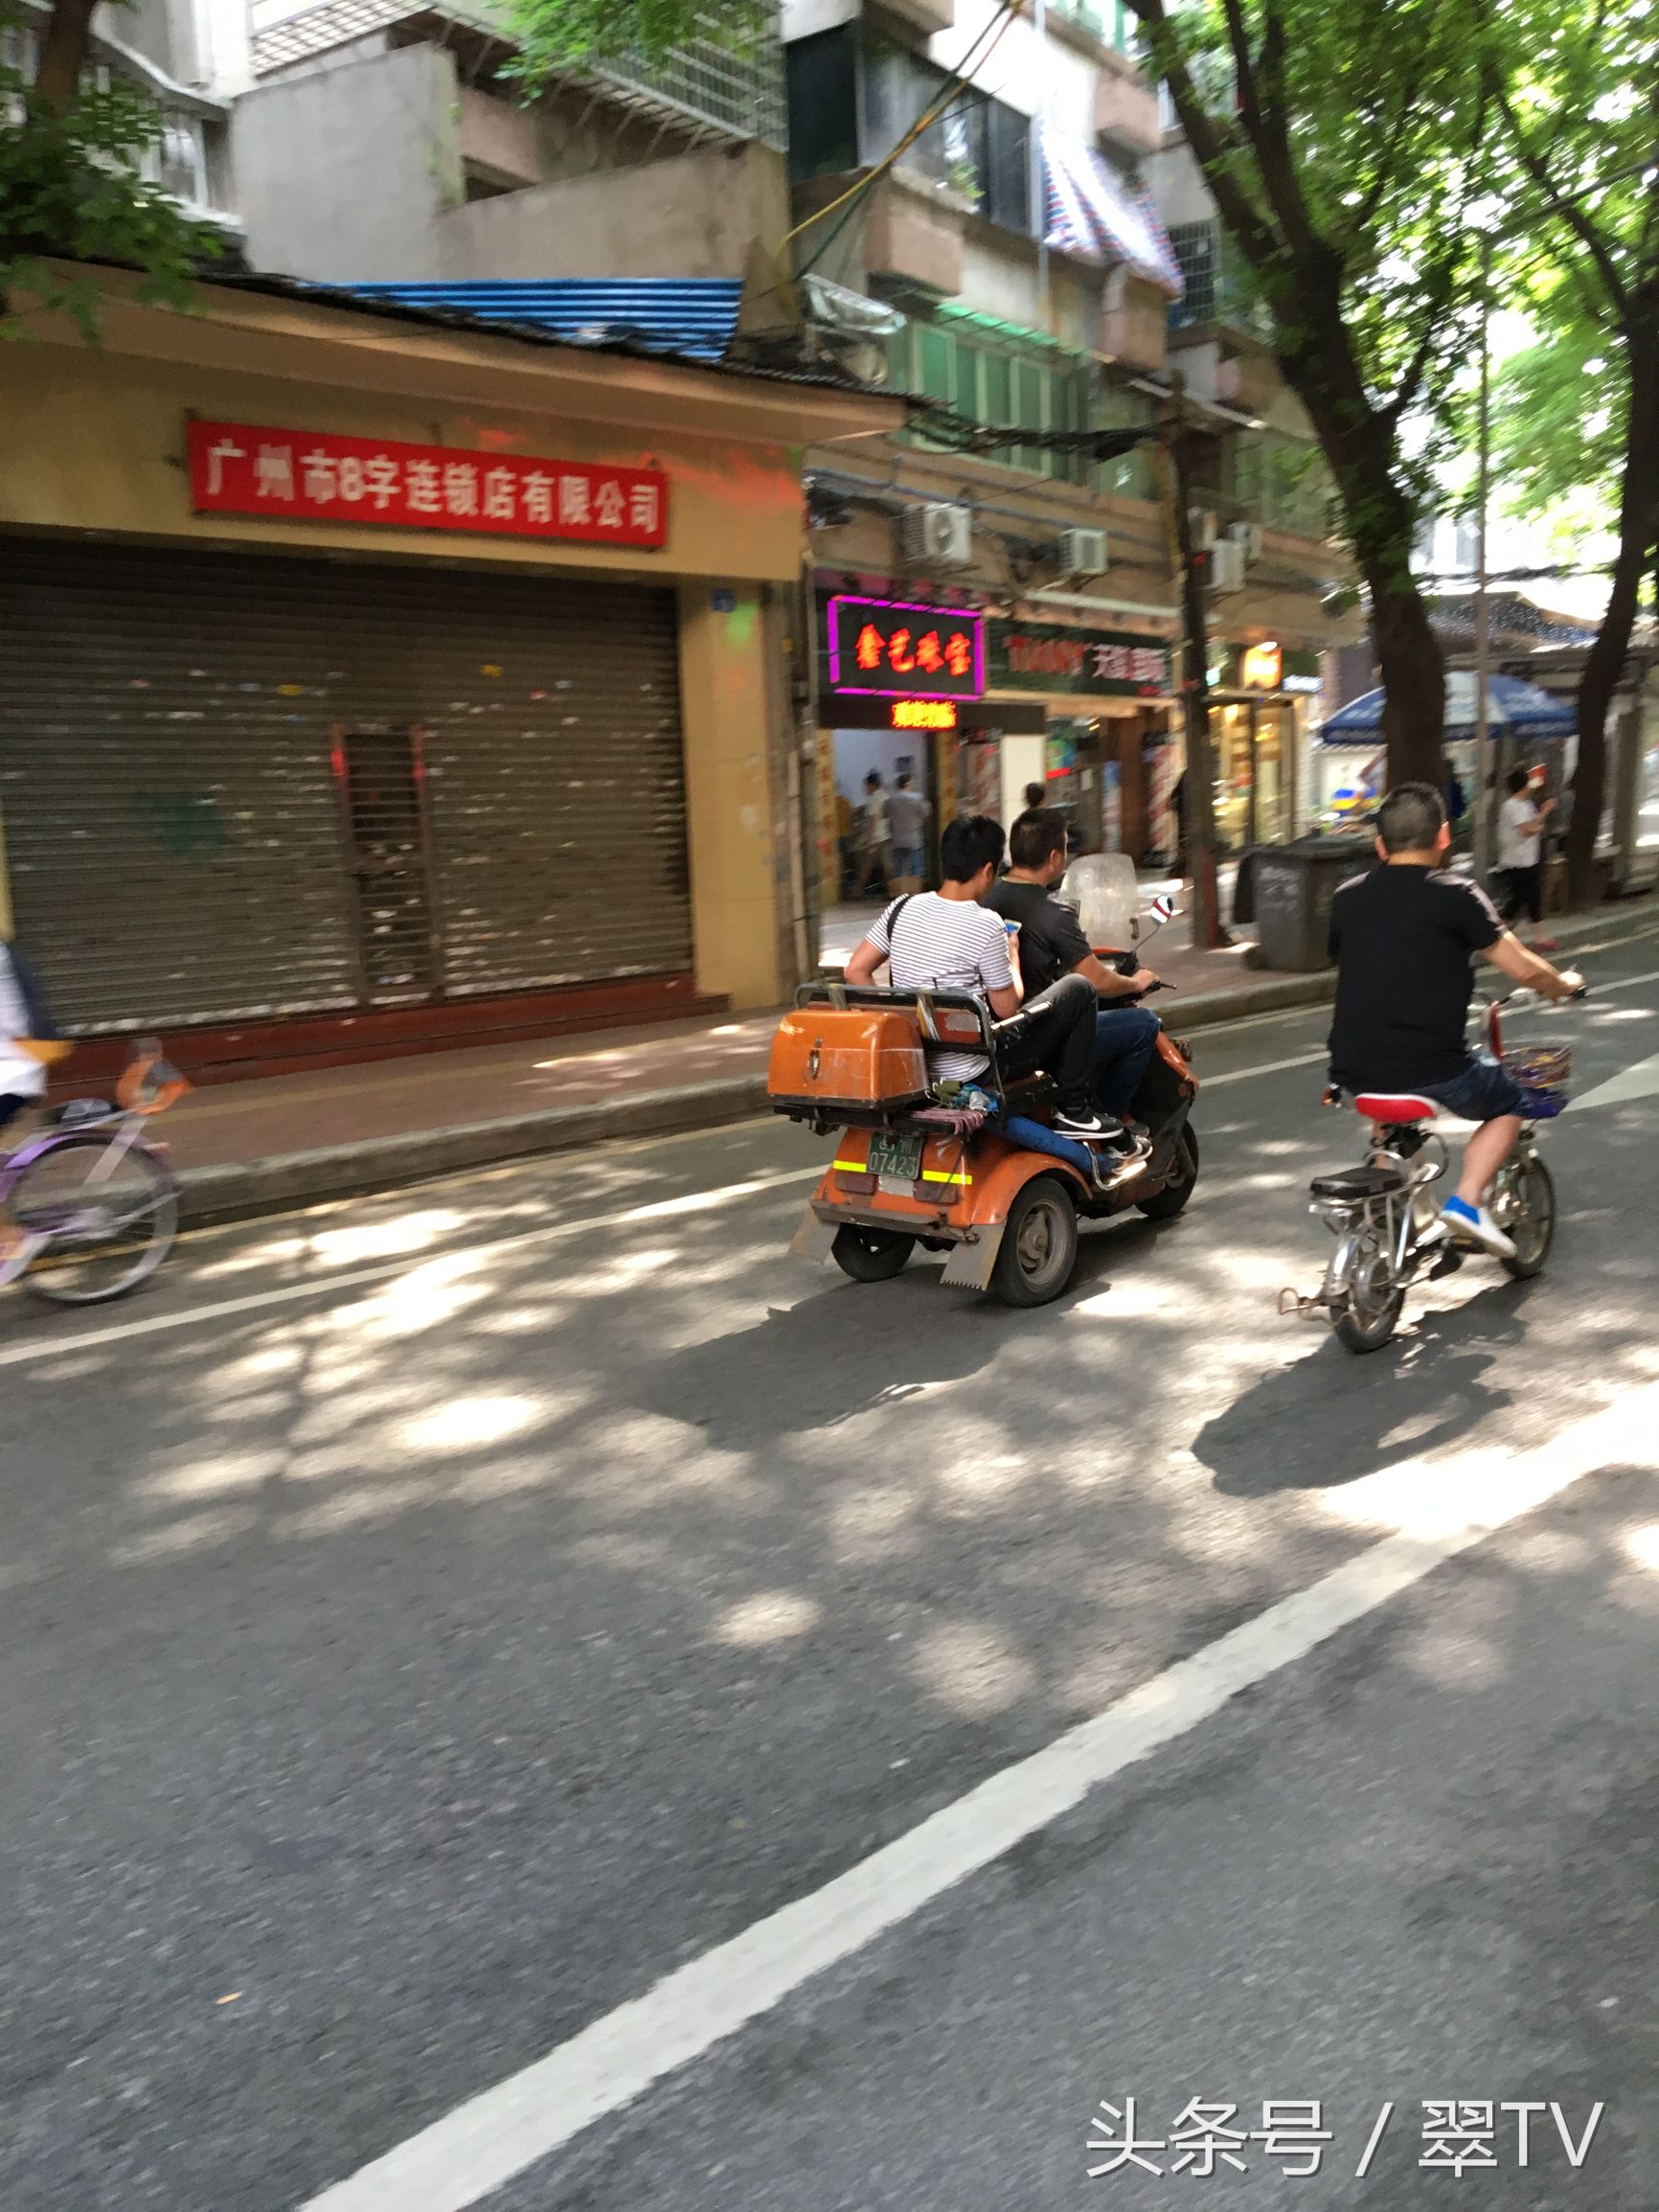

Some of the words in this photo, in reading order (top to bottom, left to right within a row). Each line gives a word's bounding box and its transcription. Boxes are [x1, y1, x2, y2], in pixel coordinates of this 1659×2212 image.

[206, 438, 660, 535] 广州市8字连锁店有限公司
[869, 1152, 917, 1176] 07423
